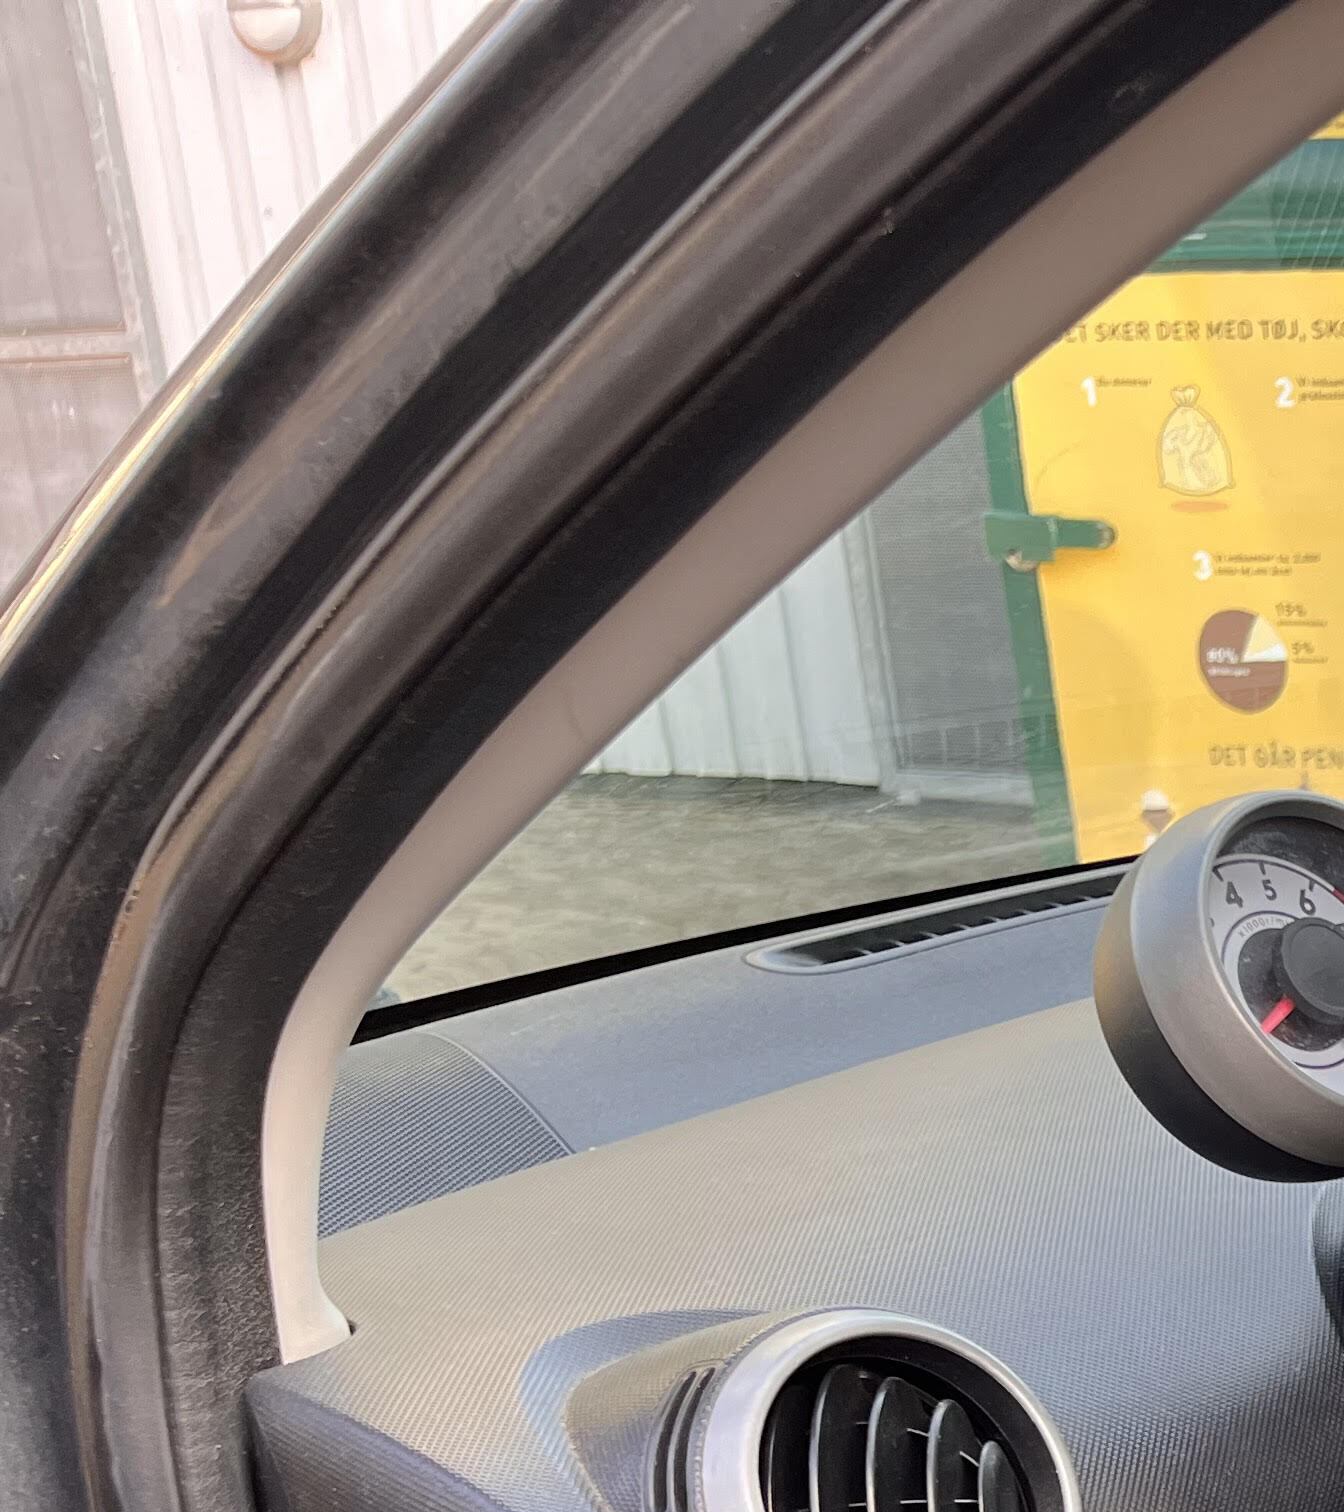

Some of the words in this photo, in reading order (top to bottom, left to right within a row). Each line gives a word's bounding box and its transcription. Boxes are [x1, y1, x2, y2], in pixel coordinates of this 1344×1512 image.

[1094, 320, 1150, 343] SKER
[1156, 320, 1200, 342] DER
[1206, 319, 1254, 341] MED
[1258, 319, 1306, 343] TØJ,
[1081, 377, 1098, 406] 1
[1274, 377, 1295, 407] 2
[1193, 550, 1213, 580] 3
[1208, 744, 1247, 767] DET
[1253, 740, 1297, 768] GÅR
[1226, 881, 1243, 908] 4
[1262, 879, 1277, 901] 5
[1300, 889, 1316, 916] 6
